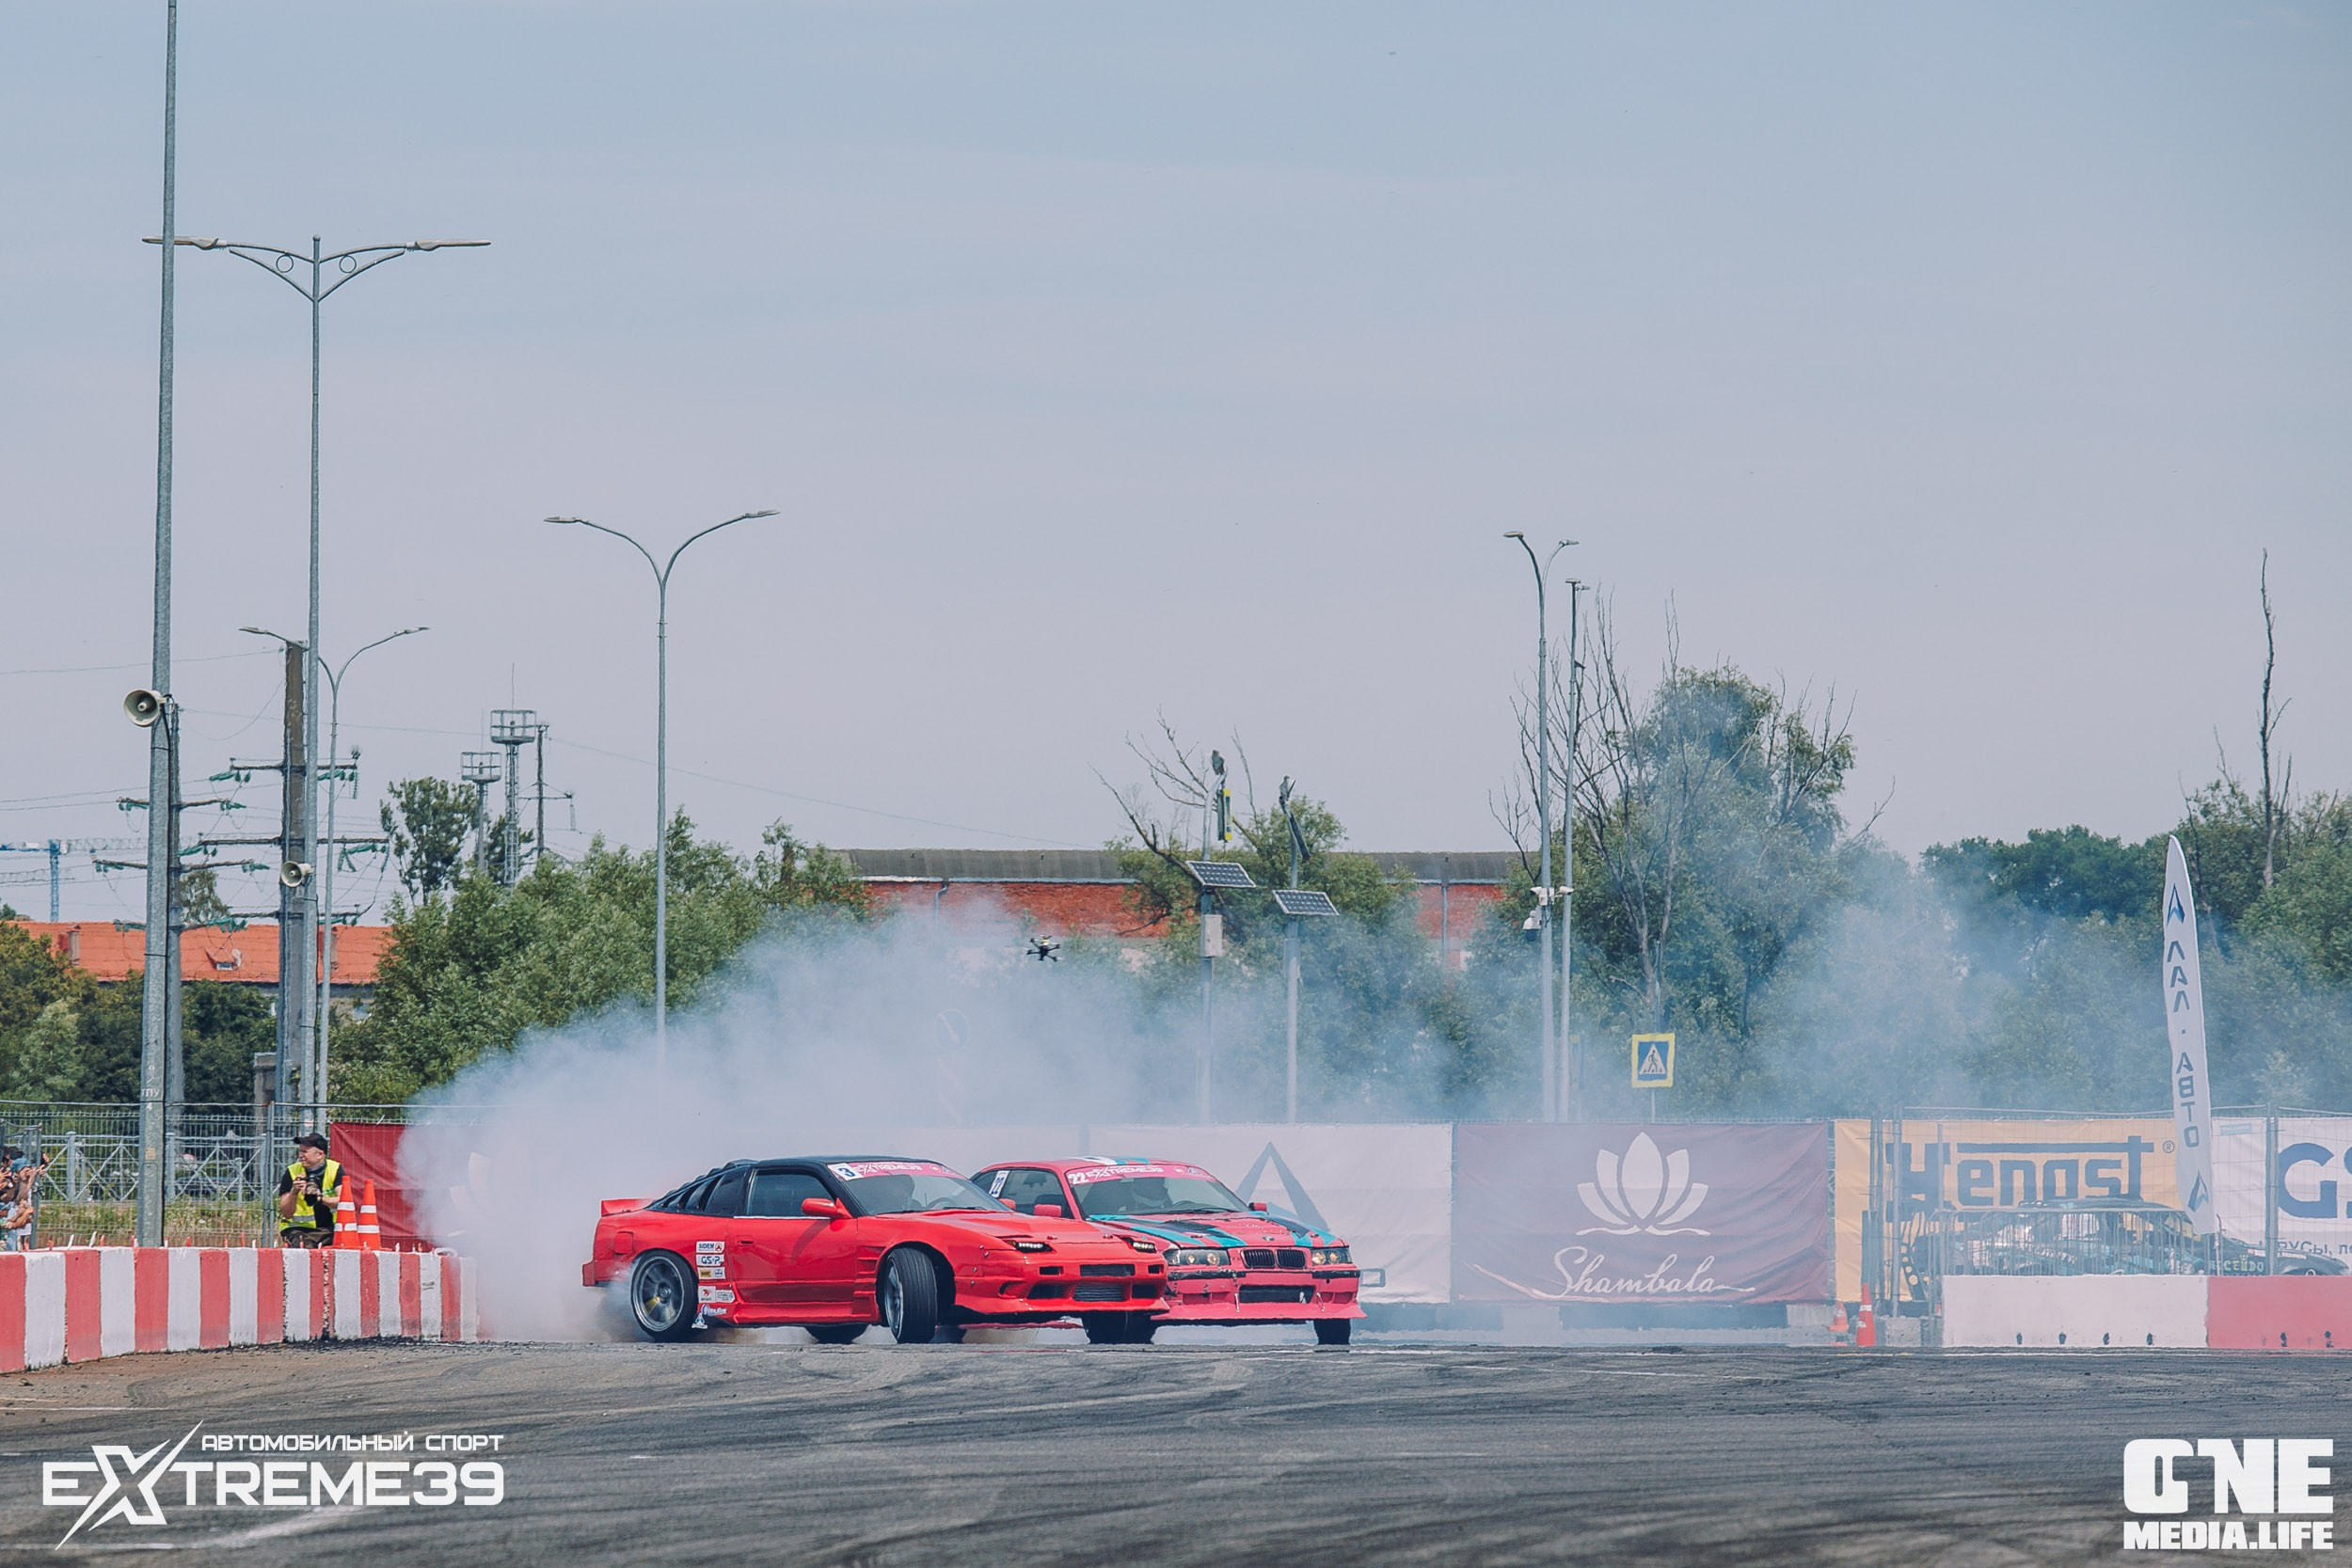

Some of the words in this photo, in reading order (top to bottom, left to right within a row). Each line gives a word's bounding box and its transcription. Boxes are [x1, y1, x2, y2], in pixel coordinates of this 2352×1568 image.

[2176, 1053, 2200, 1148] АВТО
[838, 1167, 856, 1177] 3
[1068, 1172, 1089, 1185] 22
[2278, 1142, 2352, 1219] G
[1552, 1246, 1756, 1297] Shambala
